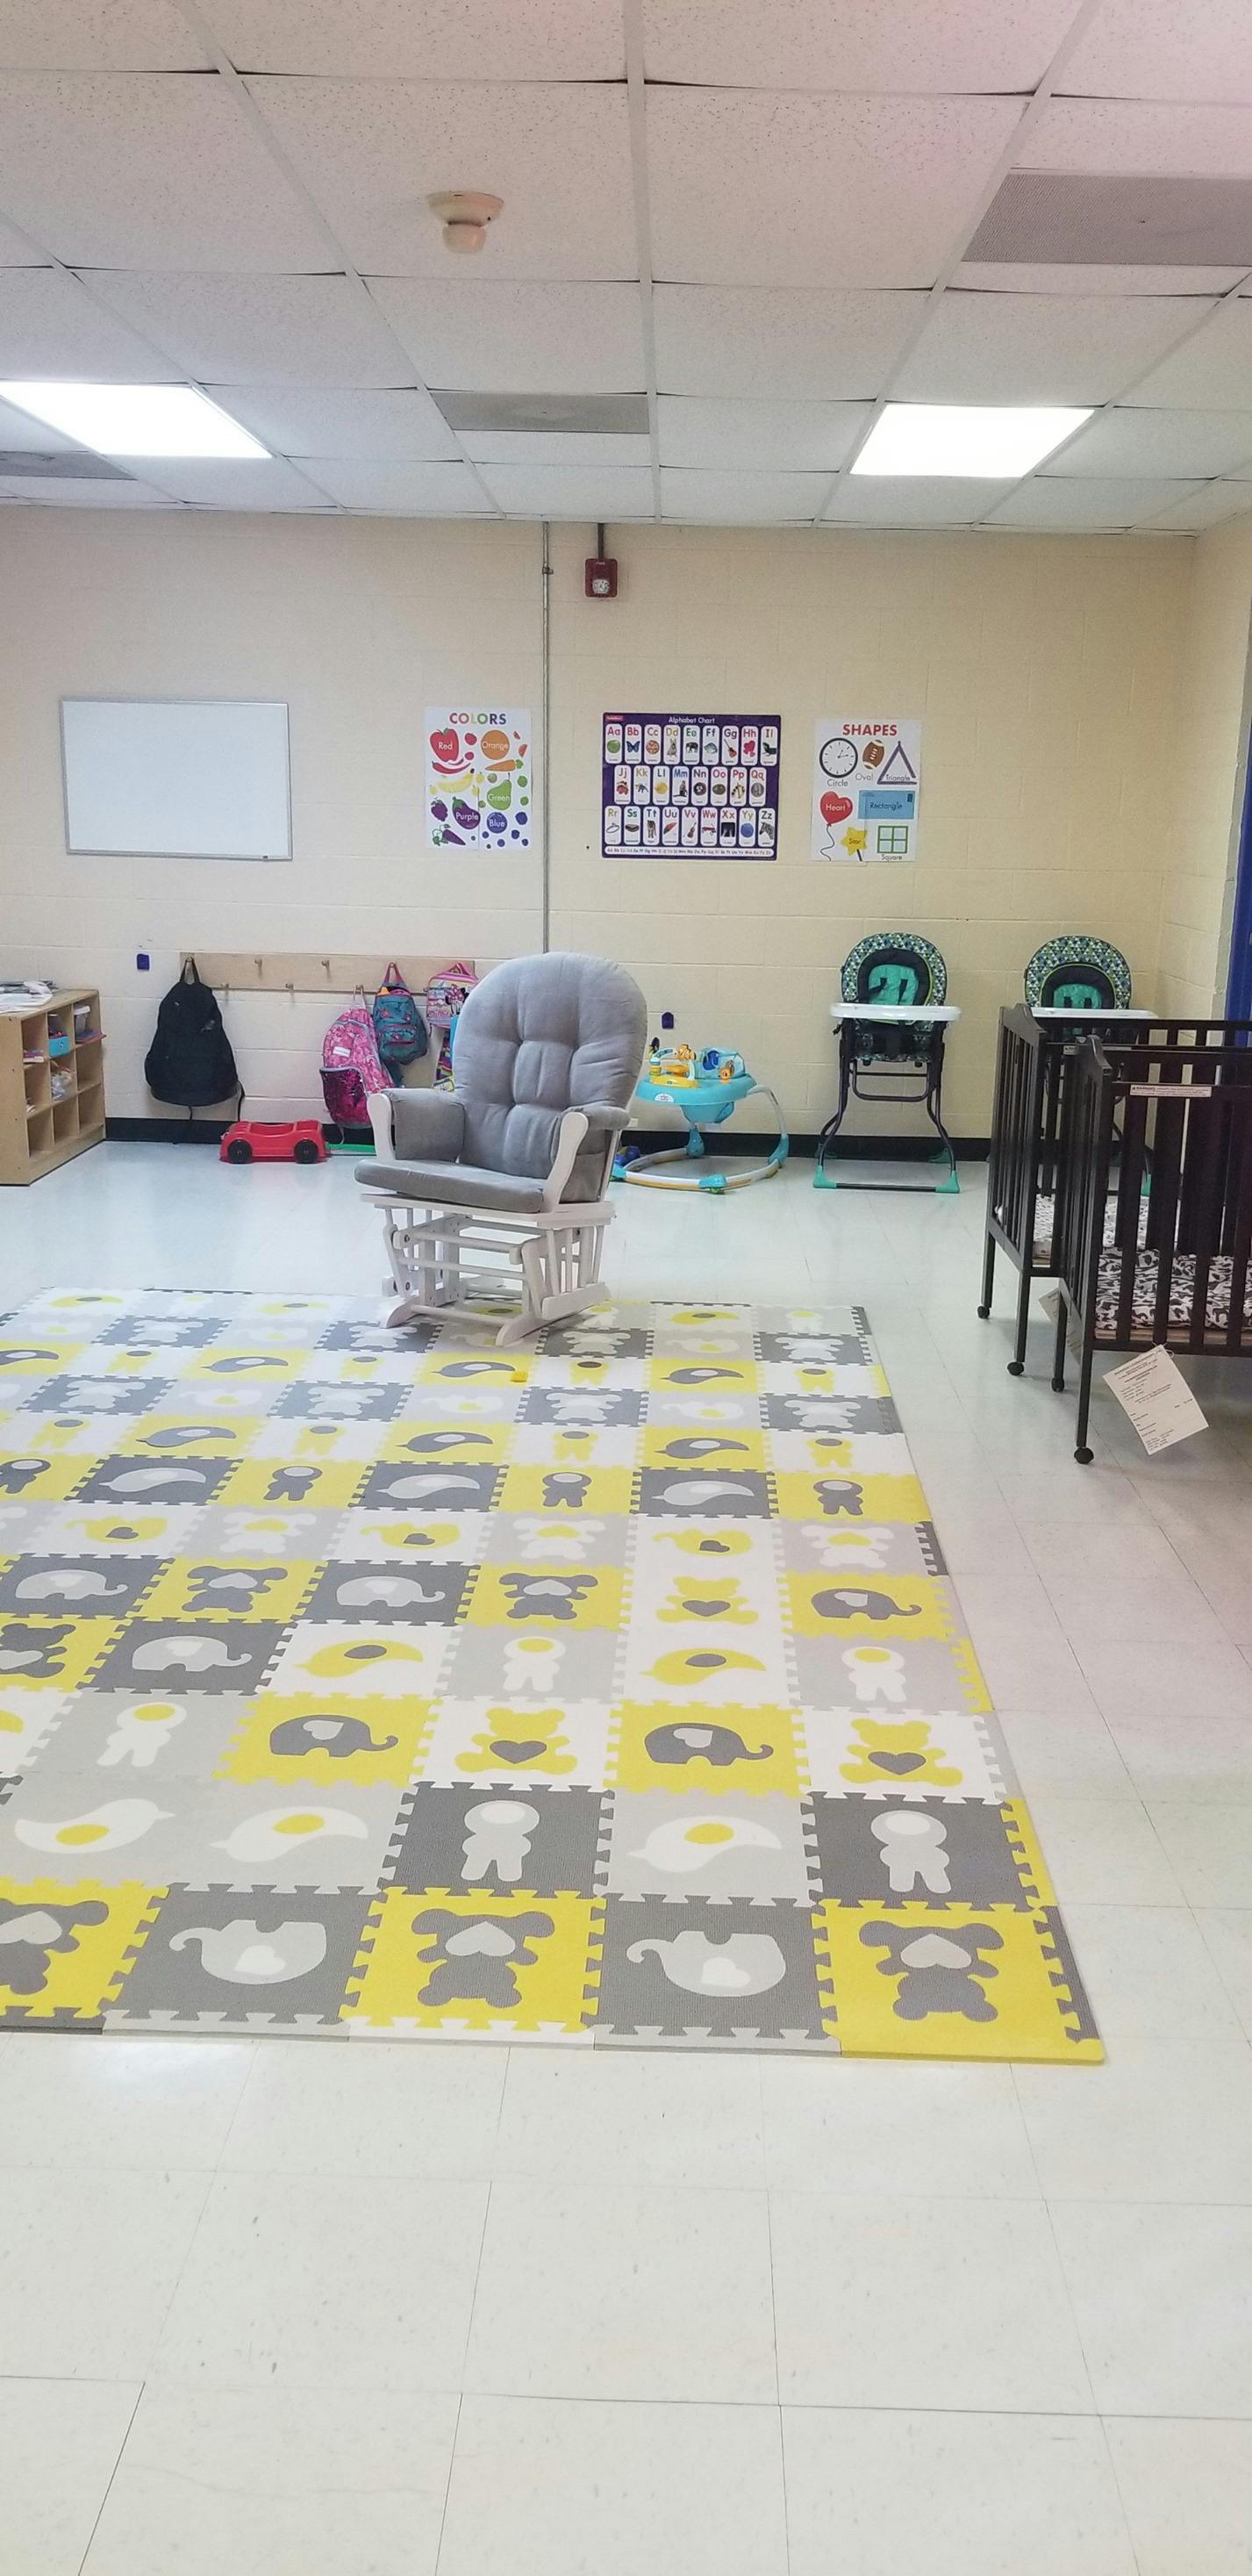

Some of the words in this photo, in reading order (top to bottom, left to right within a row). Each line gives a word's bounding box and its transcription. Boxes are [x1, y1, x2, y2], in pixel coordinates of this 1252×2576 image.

[449, 713, 507, 725] COLORS
[607, 727, 621, 735] Aa
[627, 727, 639, 735] Bb
[647, 728, 659, 736] Cc
[666, 728, 679, 736] Dd
[686, 728, 697, 736] Ee
[706, 728, 716, 737] Ff
[724, 728, 737, 739] Gg
[743, 728, 756, 737] Hh
[842, 724, 898, 736] SHAPES
[483, 742, 509, 751] Orange
[619, 768, 627, 779] Jj
[636, 768, 647, 777] Kk
[657, 769, 666, 778] Ll
[674, 769, 688, 778] Mm
[712, 770, 726, 779] Oo
[733, 770, 744, 780] Pp
[751, 770, 764, 780] Qq
[827, 779, 848, 787] Circle
[869, 801, 903, 811] Rectangle
[456, 813, 479, 822] Purple
[608, 808, 618, 817] Rr
[627, 809, 638, 818] Ss
[664, 809, 677, 818] Uu
[684, 809, 697, 818] Vv
[722, 810, 734, 819] Xx
[742, 811, 754, 821] Yy
[762, 811, 773, 820] Zz
